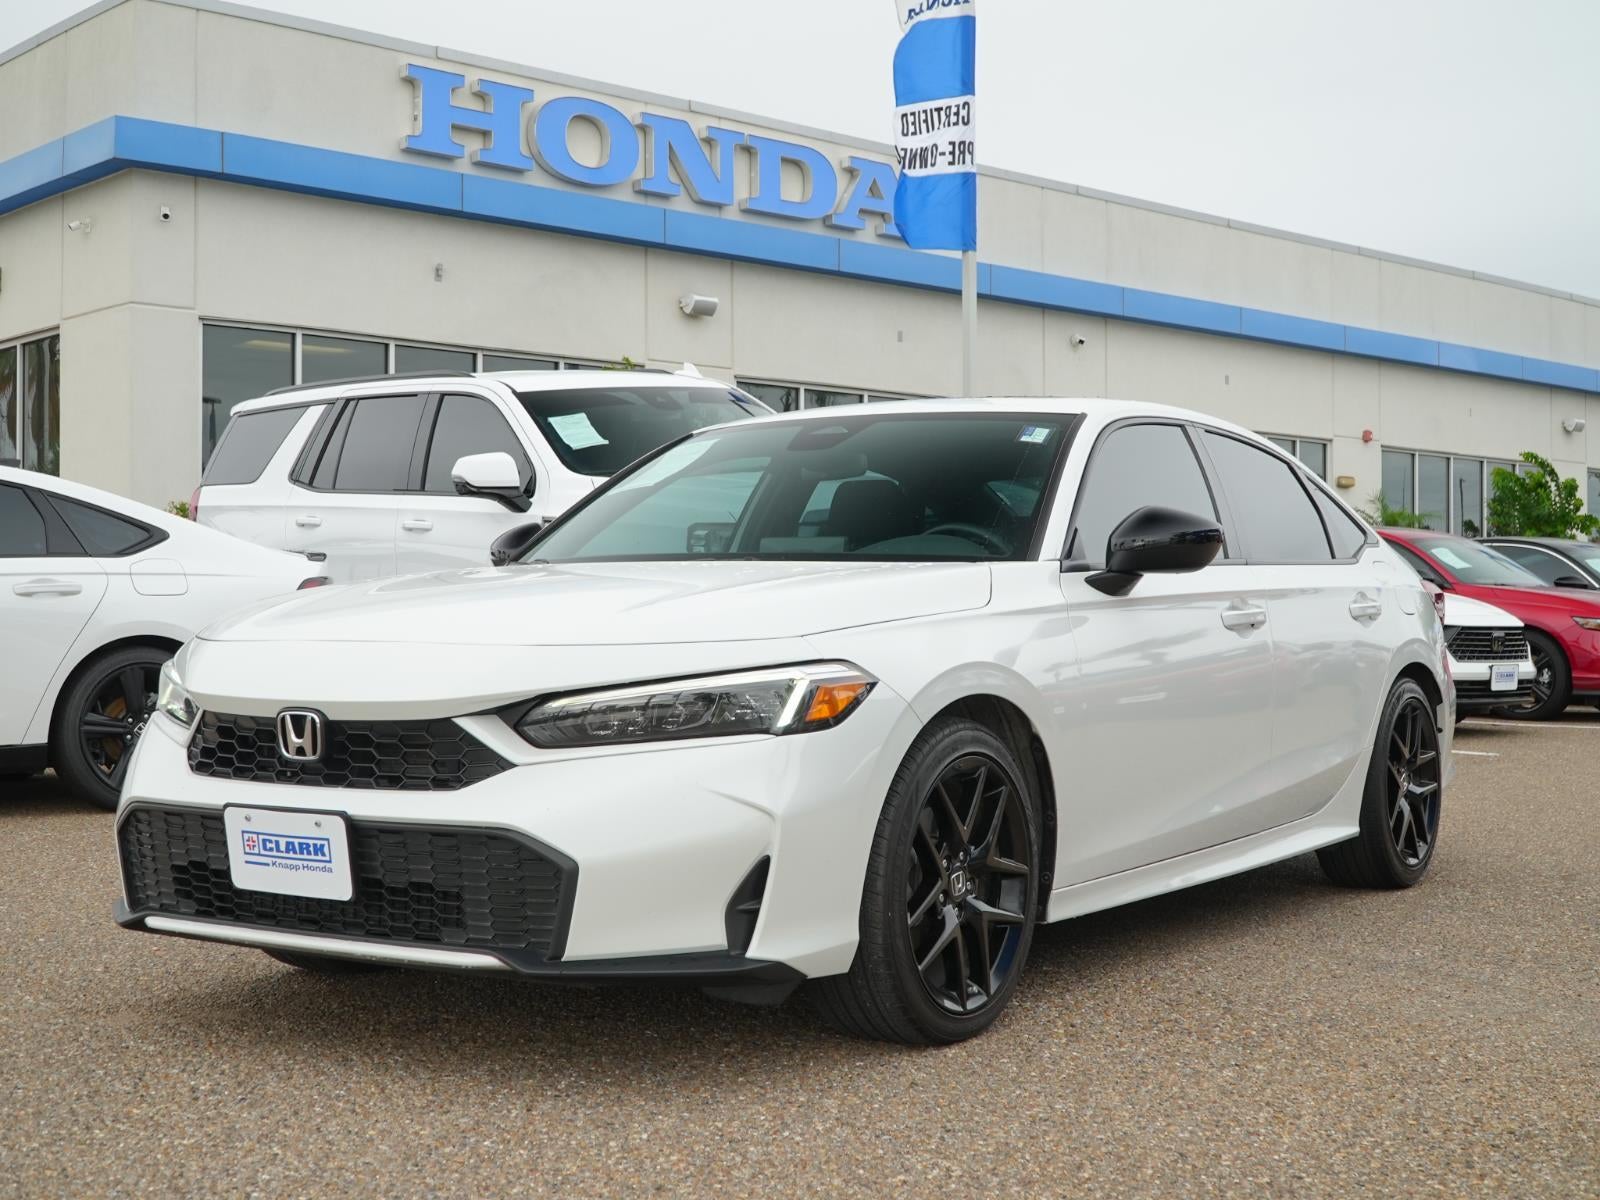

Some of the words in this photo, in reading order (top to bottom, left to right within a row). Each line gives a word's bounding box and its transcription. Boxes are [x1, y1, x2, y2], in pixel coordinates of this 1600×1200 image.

[401, 62, 902, 237] HONDA
[261, 838, 327, 858] CLARK
[271, 860, 301, 872] Knapp
[301, 863, 334, 874] Honda
